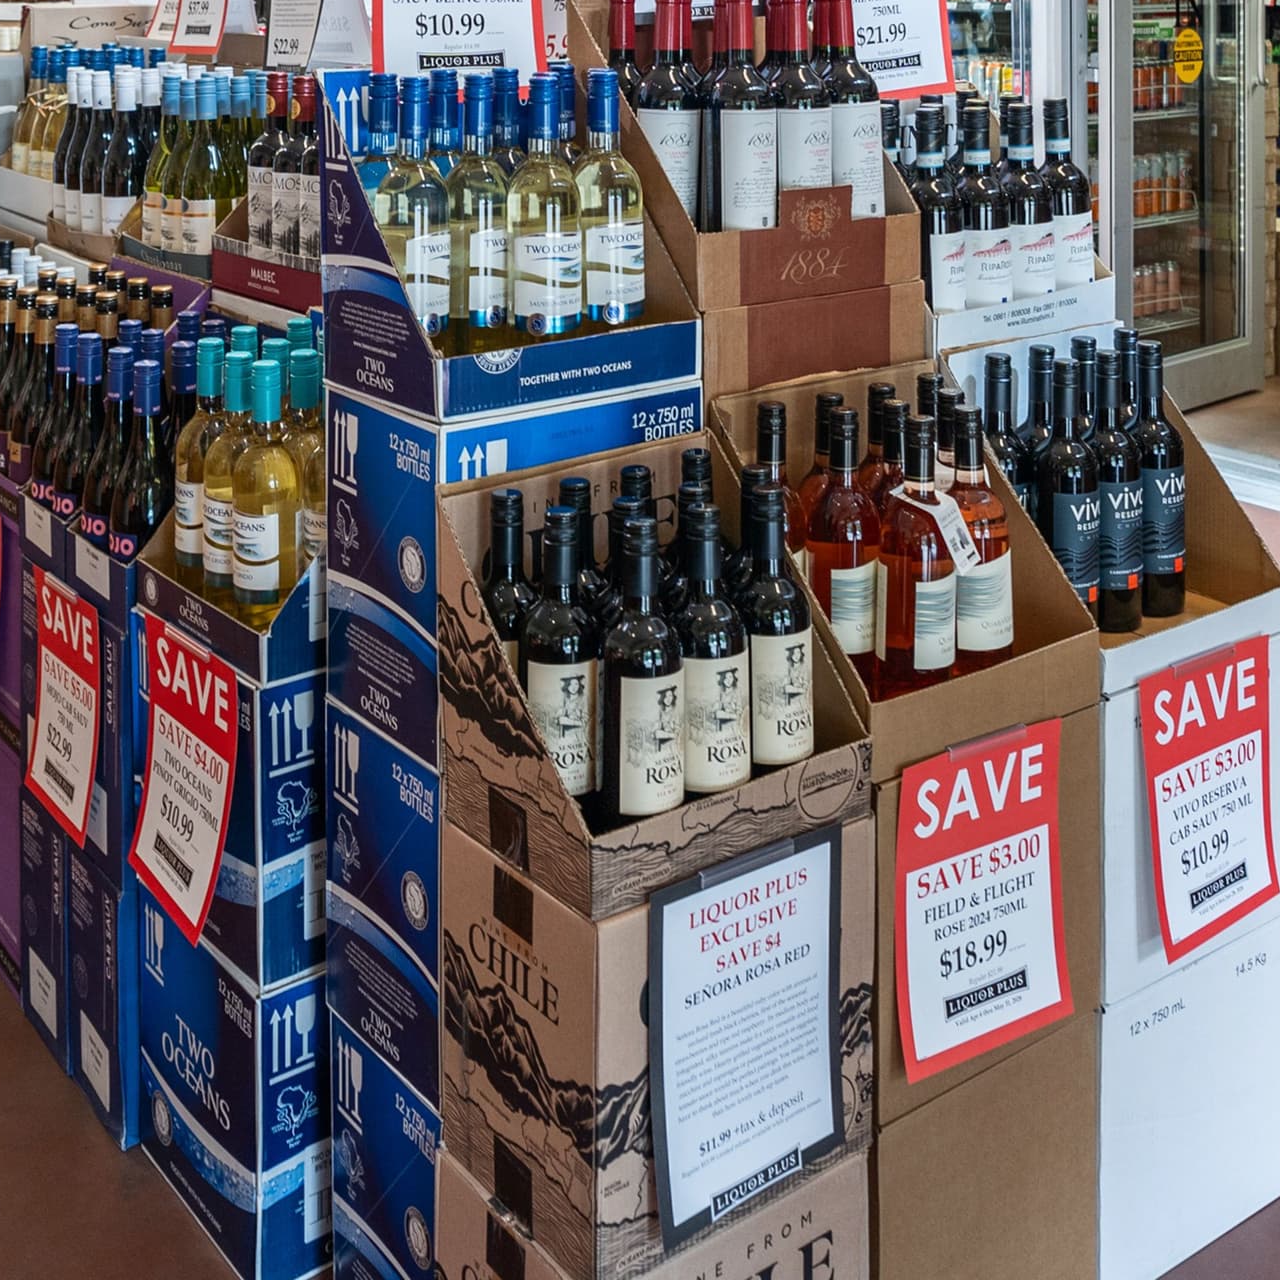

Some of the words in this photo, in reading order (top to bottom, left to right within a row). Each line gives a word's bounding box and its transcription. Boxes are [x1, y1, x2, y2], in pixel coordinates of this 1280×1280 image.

[68, 16, 118, 31] Cono
[119, 12, 153, 30] Sur
[188, 1, 209, 15] $37.99
[415, 13, 485, 37] $10.99
[872, 4, 902, 16] 750ML
[856, 22, 907, 47] $21.99
[423, 55, 470, 68] LIQUOR
[473, 55, 501, 66] PLUS
[865, 59, 896, 72] LIQUOR
[898, 56, 919, 68] PLUS
[250, 267, 277, 284] MALBEC
[520, 374, 561, 387] TOGETHER
[561, 371, 581, 382] WITH
[582, 368, 601, 378] TWO
[601, 361, 632, 376] OCEANS
[631, 411, 646, 428] 12
[647, 411, 655, 424] x
[656, 406, 679, 425] 750
[680, 403, 694, 419] ml
[644, 419, 694, 442] BOTTLES
[41, 585, 94, 664] SAVE
[44, 652, 70, 691] SAVE
[70, 679, 93, 712] $5.00
[156, 636, 229, 733] SAVE
[1154, 657, 1256, 746] SAVE
[158, 713, 192, 754] SAVE
[194, 747, 224, 786] $4.00
[1161, 759, 1212, 803] SAVE
[1215, 738, 1257, 778] $3.00
[153, 760, 173, 787] PINOT
[173, 777, 198, 812] GRIGIO
[198, 802, 219, 833] 750ML
[913, 743, 1044, 840] SAVE
[1172, 797, 1200, 823] VIVO
[1202, 775, 1248, 808] RESERVA
[160, 793, 194, 843] $10.99
[1169, 823, 1191, 846] CAB
[1192, 810, 1220, 836] SAUV
[1221, 802, 1237, 821] 750
[1237, 791, 1254, 812] ML
[917, 853, 984, 900] SAVE
[989, 832, 1041, 876] $3.00
[1180, 828, 1230, 877] $10.99
[688, 886, 760, 930] LIQUOR
[765, 867, 808, 899] PLUS
[933, 918, 967, 943] ROSE
[968, 910, 992, 931] 2024
[992, 899, 1028, 925] 750ML
[699, 898, 798, 953] EXCLUSIVE
[468, 922, 560, 1026] CHILE
[684, 973, 742, 1010] SEÑORA
[745, 957, 781, 987] ROSA
[784, 943, 811, 965] RED
[716, 939, 762, 973] SAVE
[765, 931, 782, 953] $4
[939, 929, 1008, 980] $18.99
[1235, 959, 1254, 976] 14.5
[1254, 952, 1268, 967] Kg
[1129, 1022, 1141, 1036] 12
[1143, 1019, 1150, 1030] x
[1151, 1006, 1169, 1025] 750
[1171, 998, 1186, 1015] mL
[175, 1014, 215, 1080] TWO
[161, 1032, 231, 1131] OCEANS
[698, 1128, 732, 1157] $11.99
[757, 1111, 768, 1124] &
[769, 1090, 805, 1120] deposit
